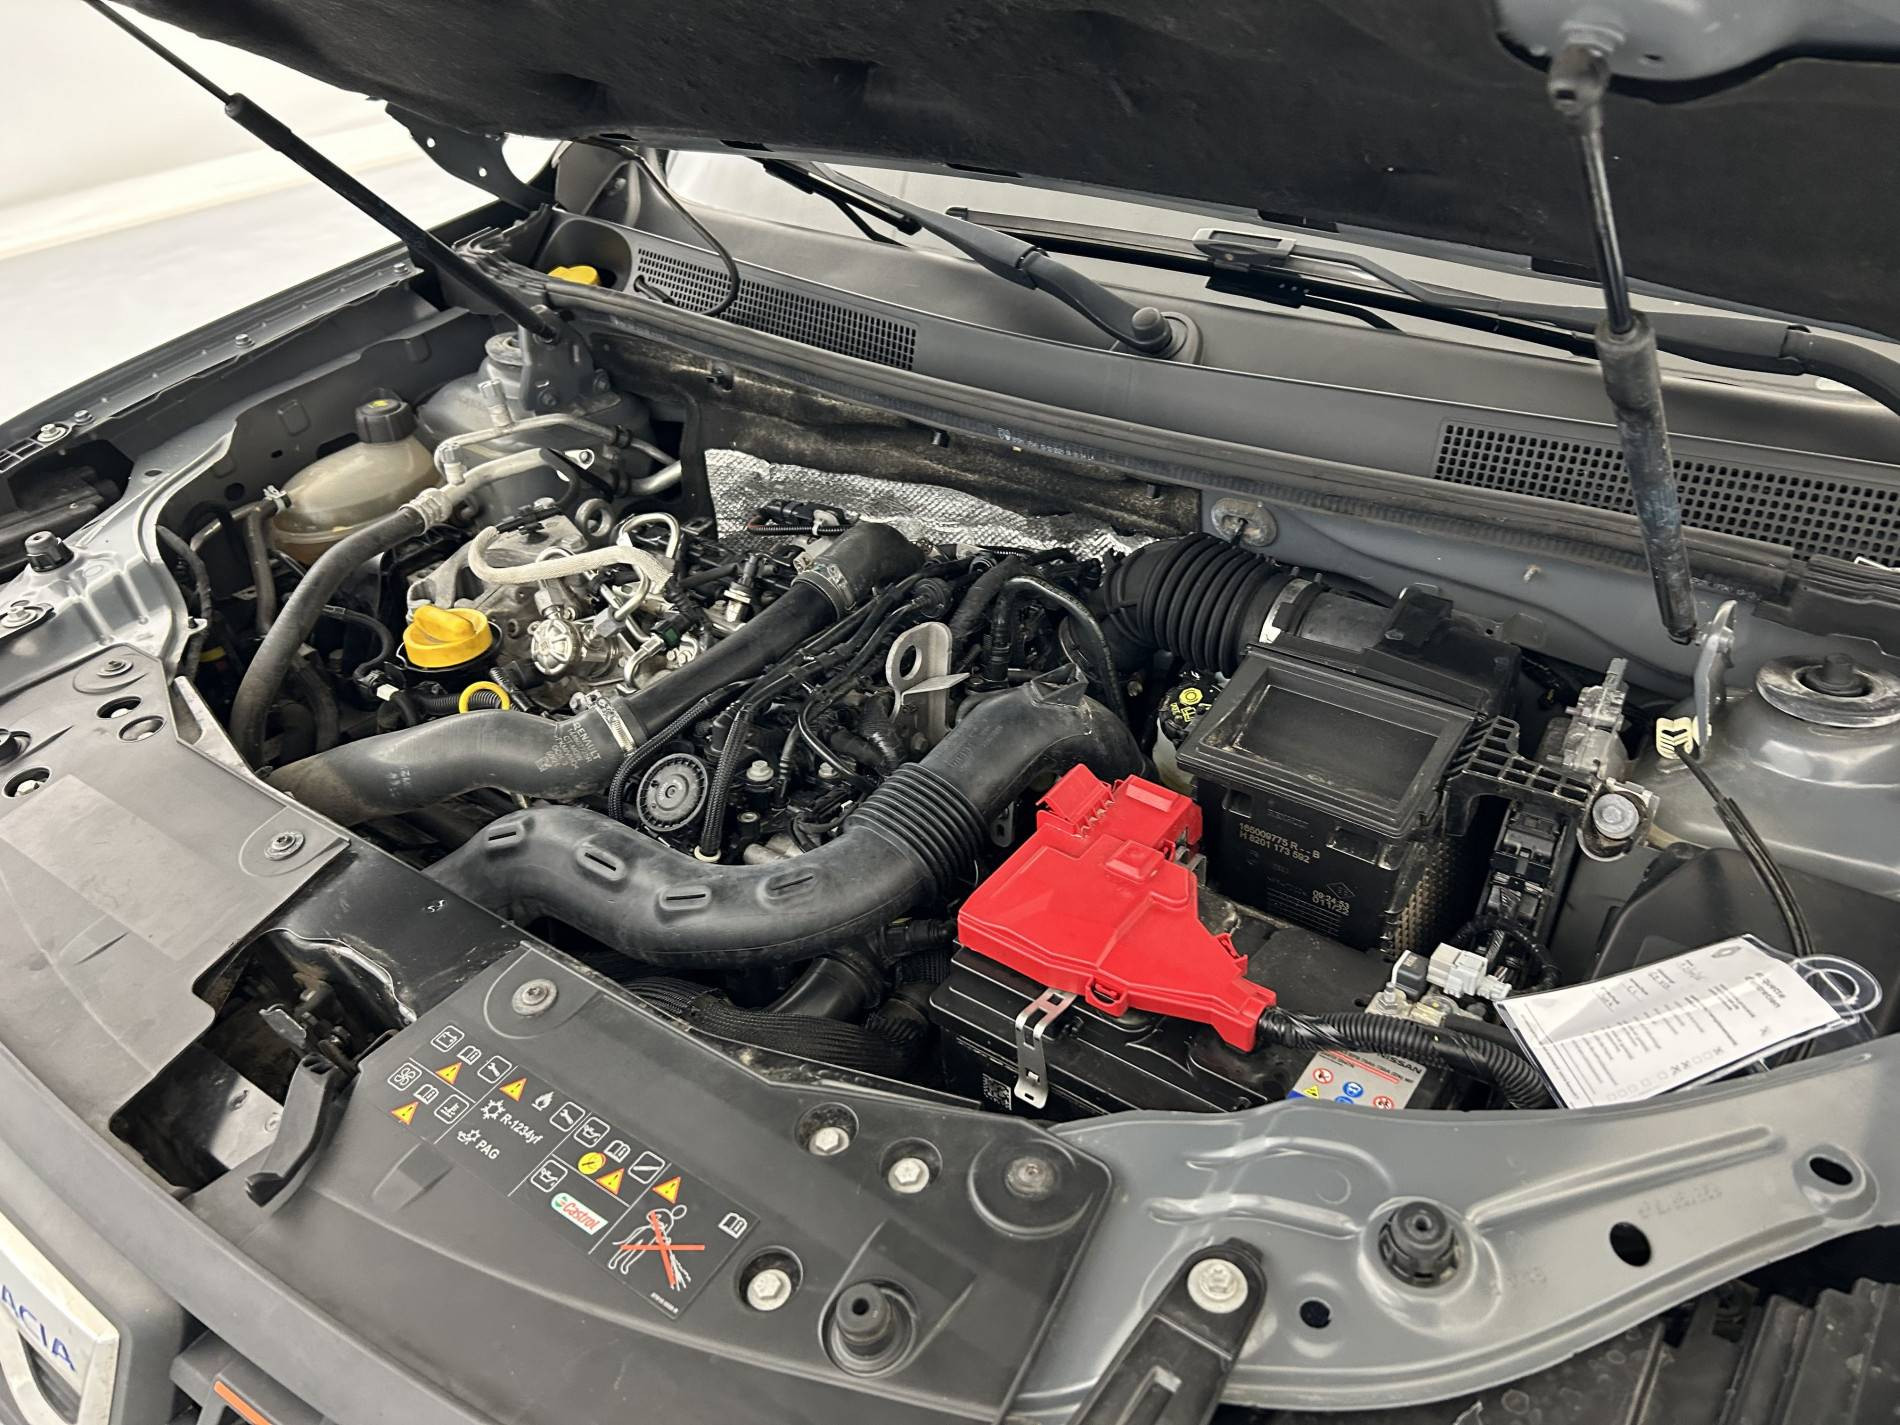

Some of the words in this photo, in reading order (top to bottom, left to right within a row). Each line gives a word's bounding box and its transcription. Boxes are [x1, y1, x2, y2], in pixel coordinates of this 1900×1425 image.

[573, 721, 602, 760] RENAULT
[1273, 844, 1291, 856] 173
[1376, 1052, 1422, 1074] NISSAN
[499, 1113, 544, 1145] R-1234yf
[475, 1140, 501, 1160] PAG
[563, 1202, 600, 1231] Castrol
